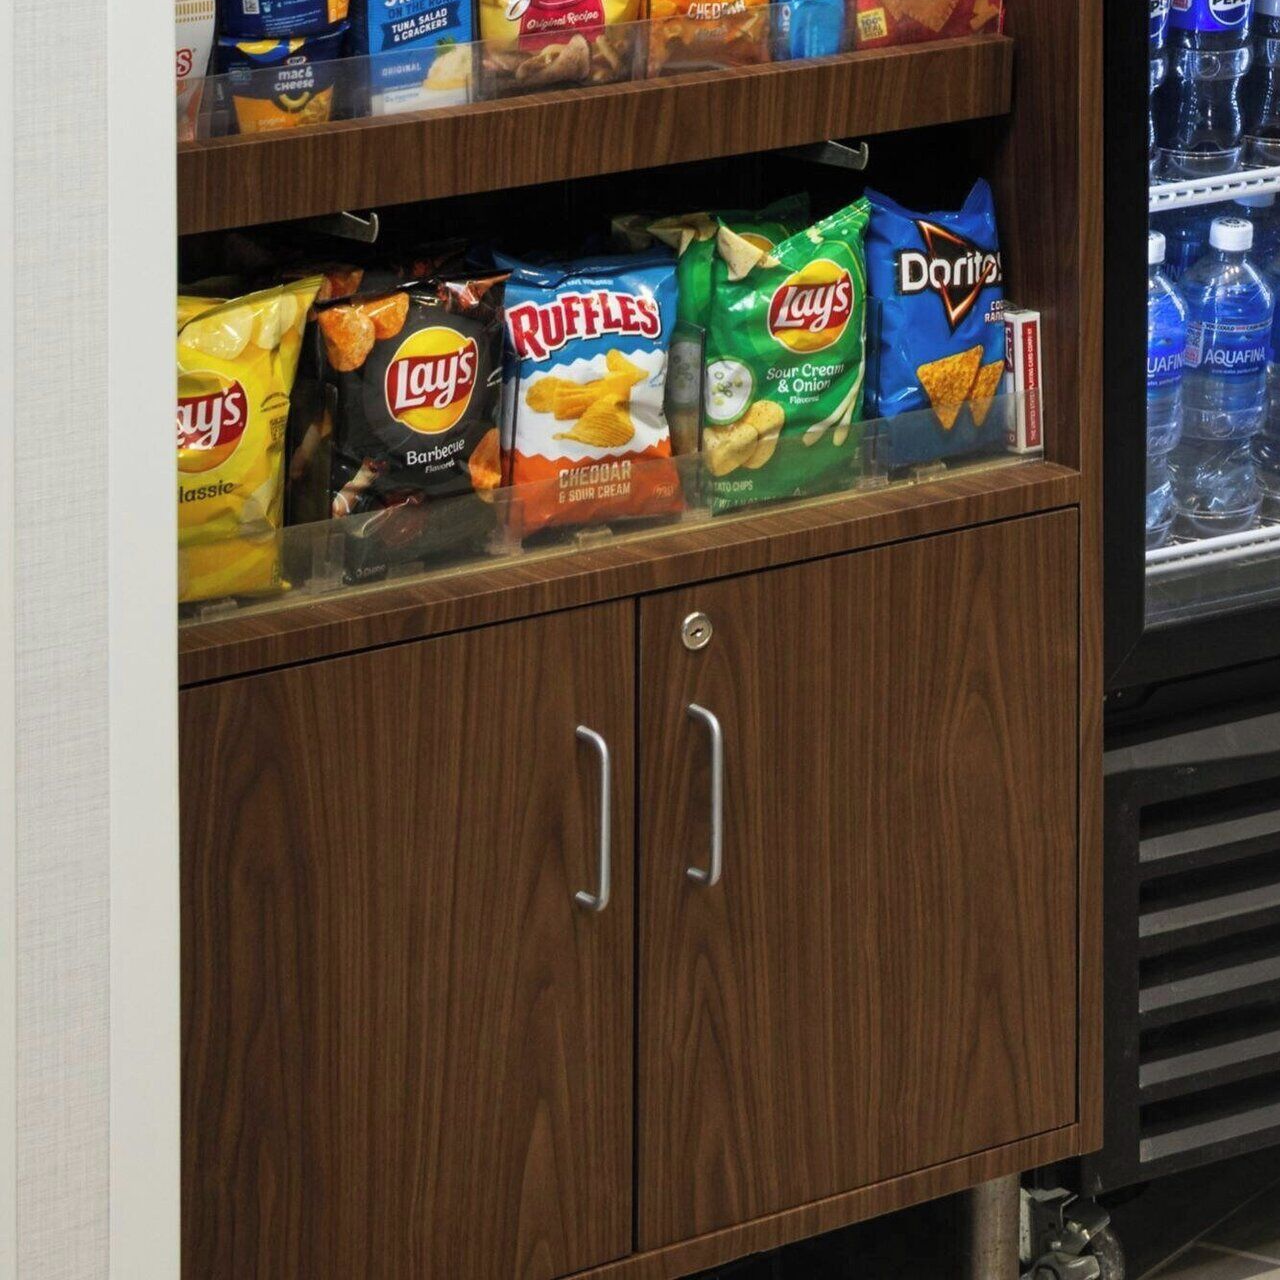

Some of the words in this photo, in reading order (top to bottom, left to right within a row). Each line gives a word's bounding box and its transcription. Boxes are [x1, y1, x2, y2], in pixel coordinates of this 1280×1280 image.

[391, 20, 417, 34] TUNA
[417, 7, 448, 27] SALAD
[394, 31, 400, 42] &
[401, 17, 448, 40] CRACKERS
[526, 14, 565, 33] Original
[565, 7, 600, 28] Recipe
[381, 63, 422, 77] ORIGINAL
[772, 278, 851, 338] Lay's
[508, 287, 663, 362] RUFFLES
[1203, 346, 1266, 367] AQUAFINA
[395, 345, 477, 410] Lay's
[766, 366, 799, 381] Sour
[801, 363, 845, 377] Cream
[777, 379, 790, 394] &
[792, 377, 831, 393] Onion
[789, 395, 820, 405] Flavored
[175, 386, 242, 451] ay's
[405, 438, 466, 467] Barbecue
[425, 459, 456, 475] Flavored
[559, 459, 633, 489] CHEDDAR
[568, 488, 595, 503] SOUR
[597, 482, 632, 499] CREAM
[732, 479, 754, 492] CHIPS
